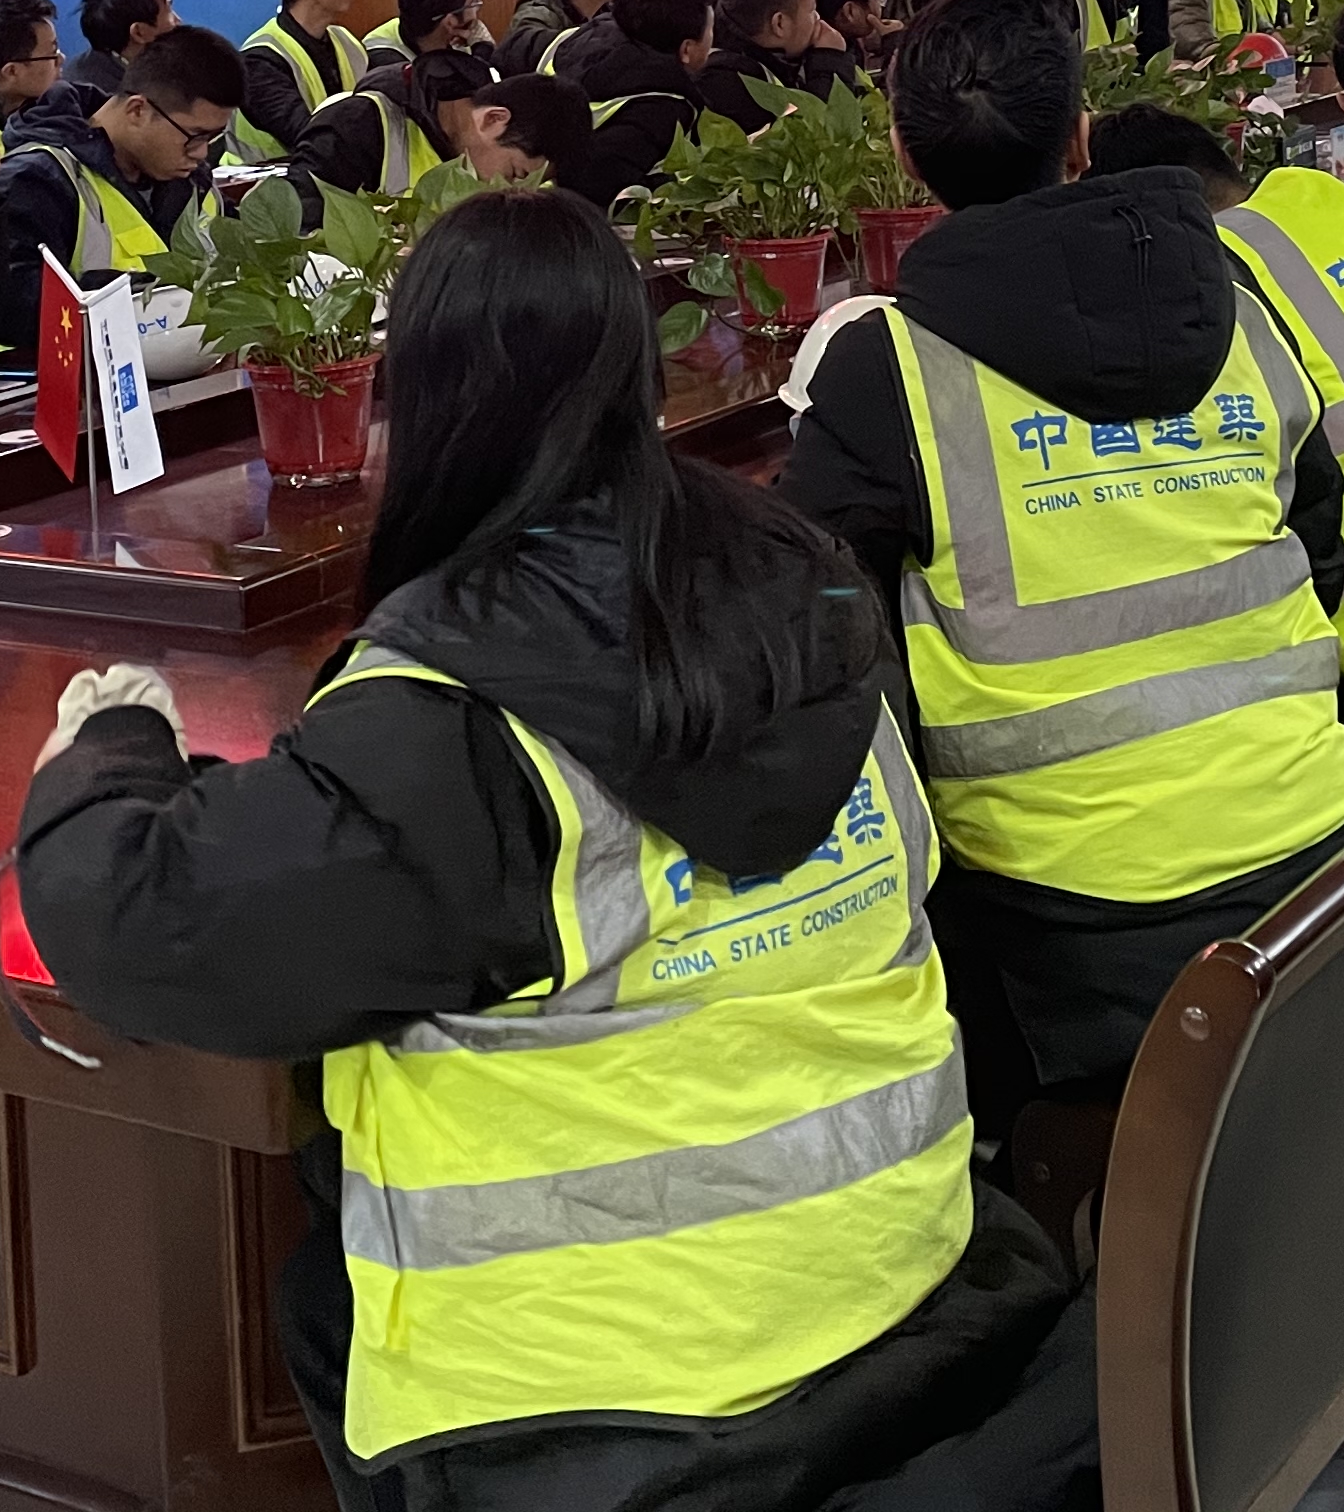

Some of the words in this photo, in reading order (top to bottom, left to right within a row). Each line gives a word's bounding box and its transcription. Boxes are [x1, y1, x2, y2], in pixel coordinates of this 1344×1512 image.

[1025, 491, 1082, 515] CHINA
[1093, 482, 1144, 504] STATE
[1153, 467, 1266, 495] CONSTRUCTION
[652, 949, 718, 981] CHINA
[729, 923, 792, 962] STATE
[801, 873, 899, 937] CONSTRUCTION
